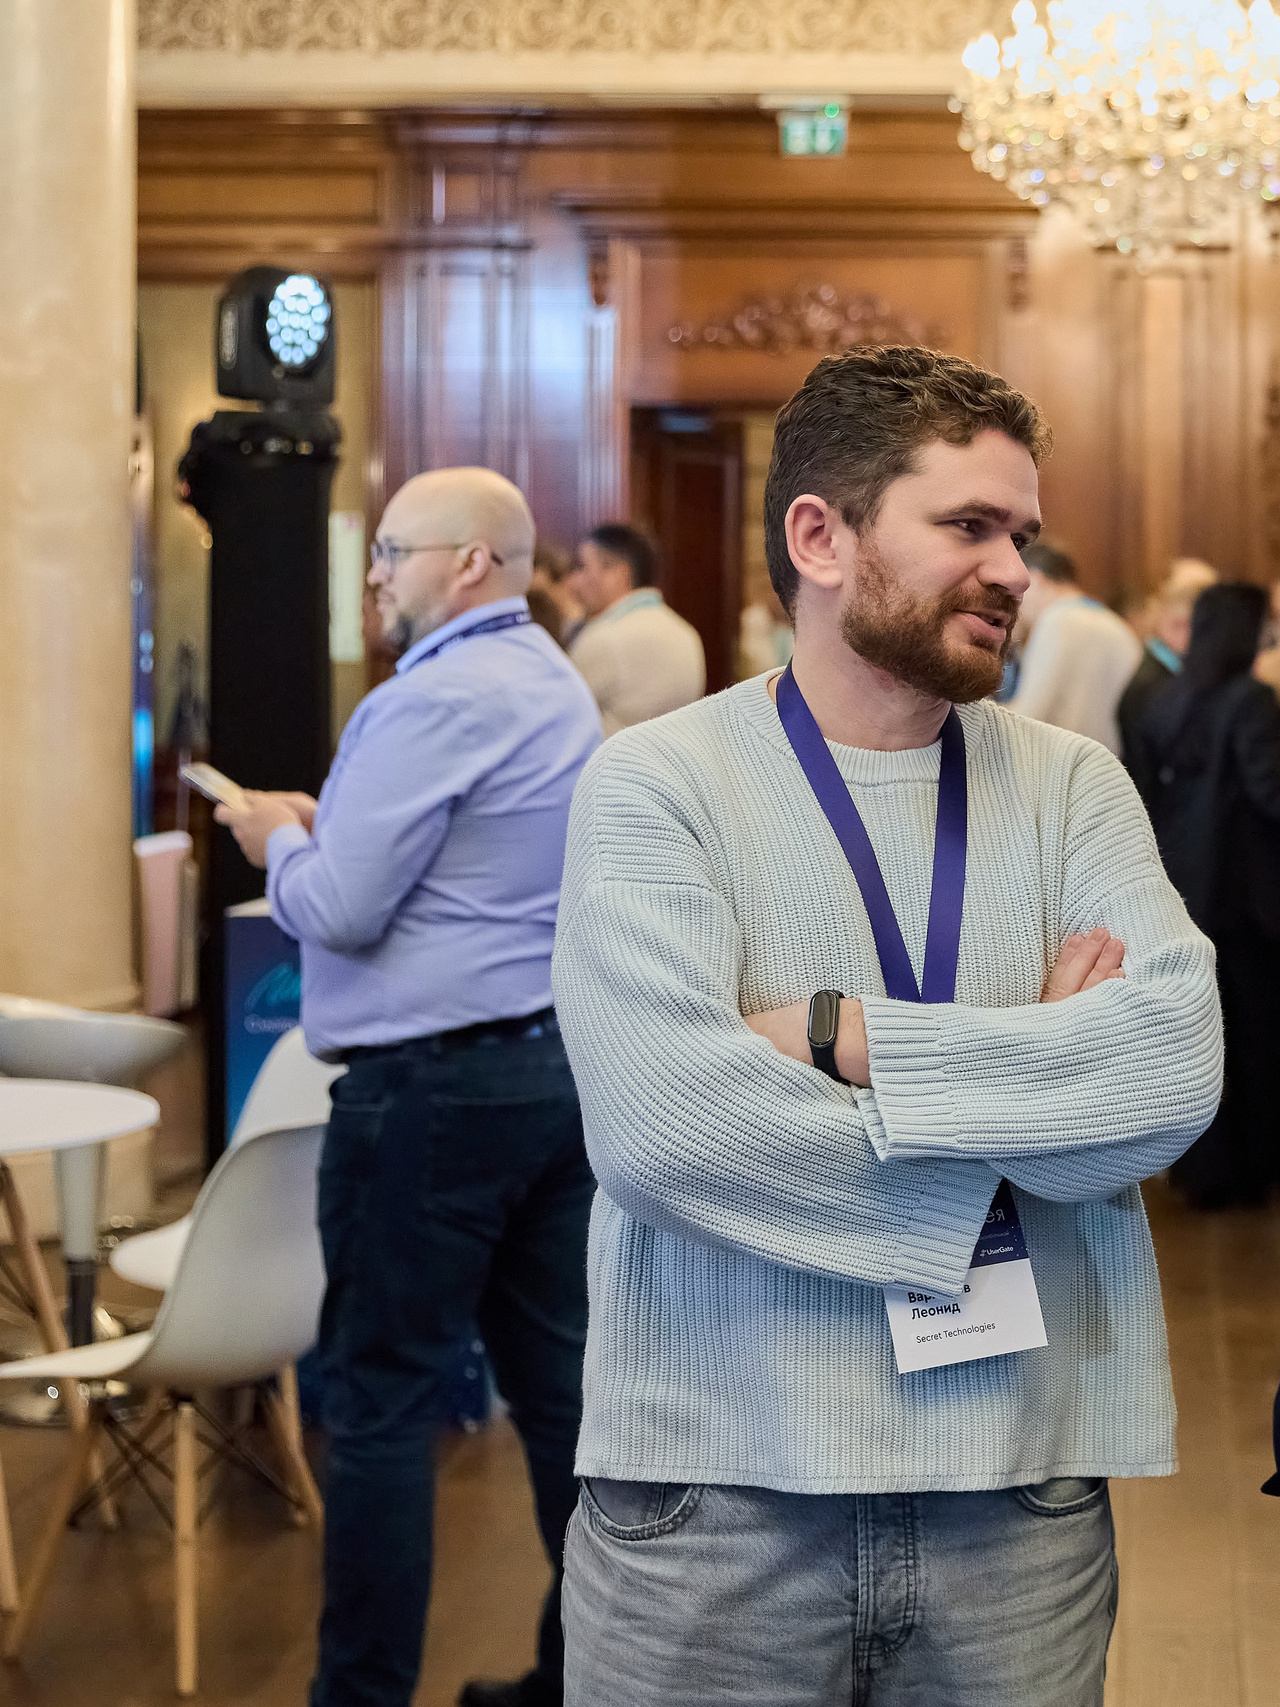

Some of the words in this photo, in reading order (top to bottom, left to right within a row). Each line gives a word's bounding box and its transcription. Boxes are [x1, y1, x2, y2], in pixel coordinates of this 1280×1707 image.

[986, 1245, 1014, 1256] UserGate
[911, 1303, 961, 1320] Леонид
[916, 1333, 942, 1344] Secret
[943, 1322, 996, 1338] Technologies
